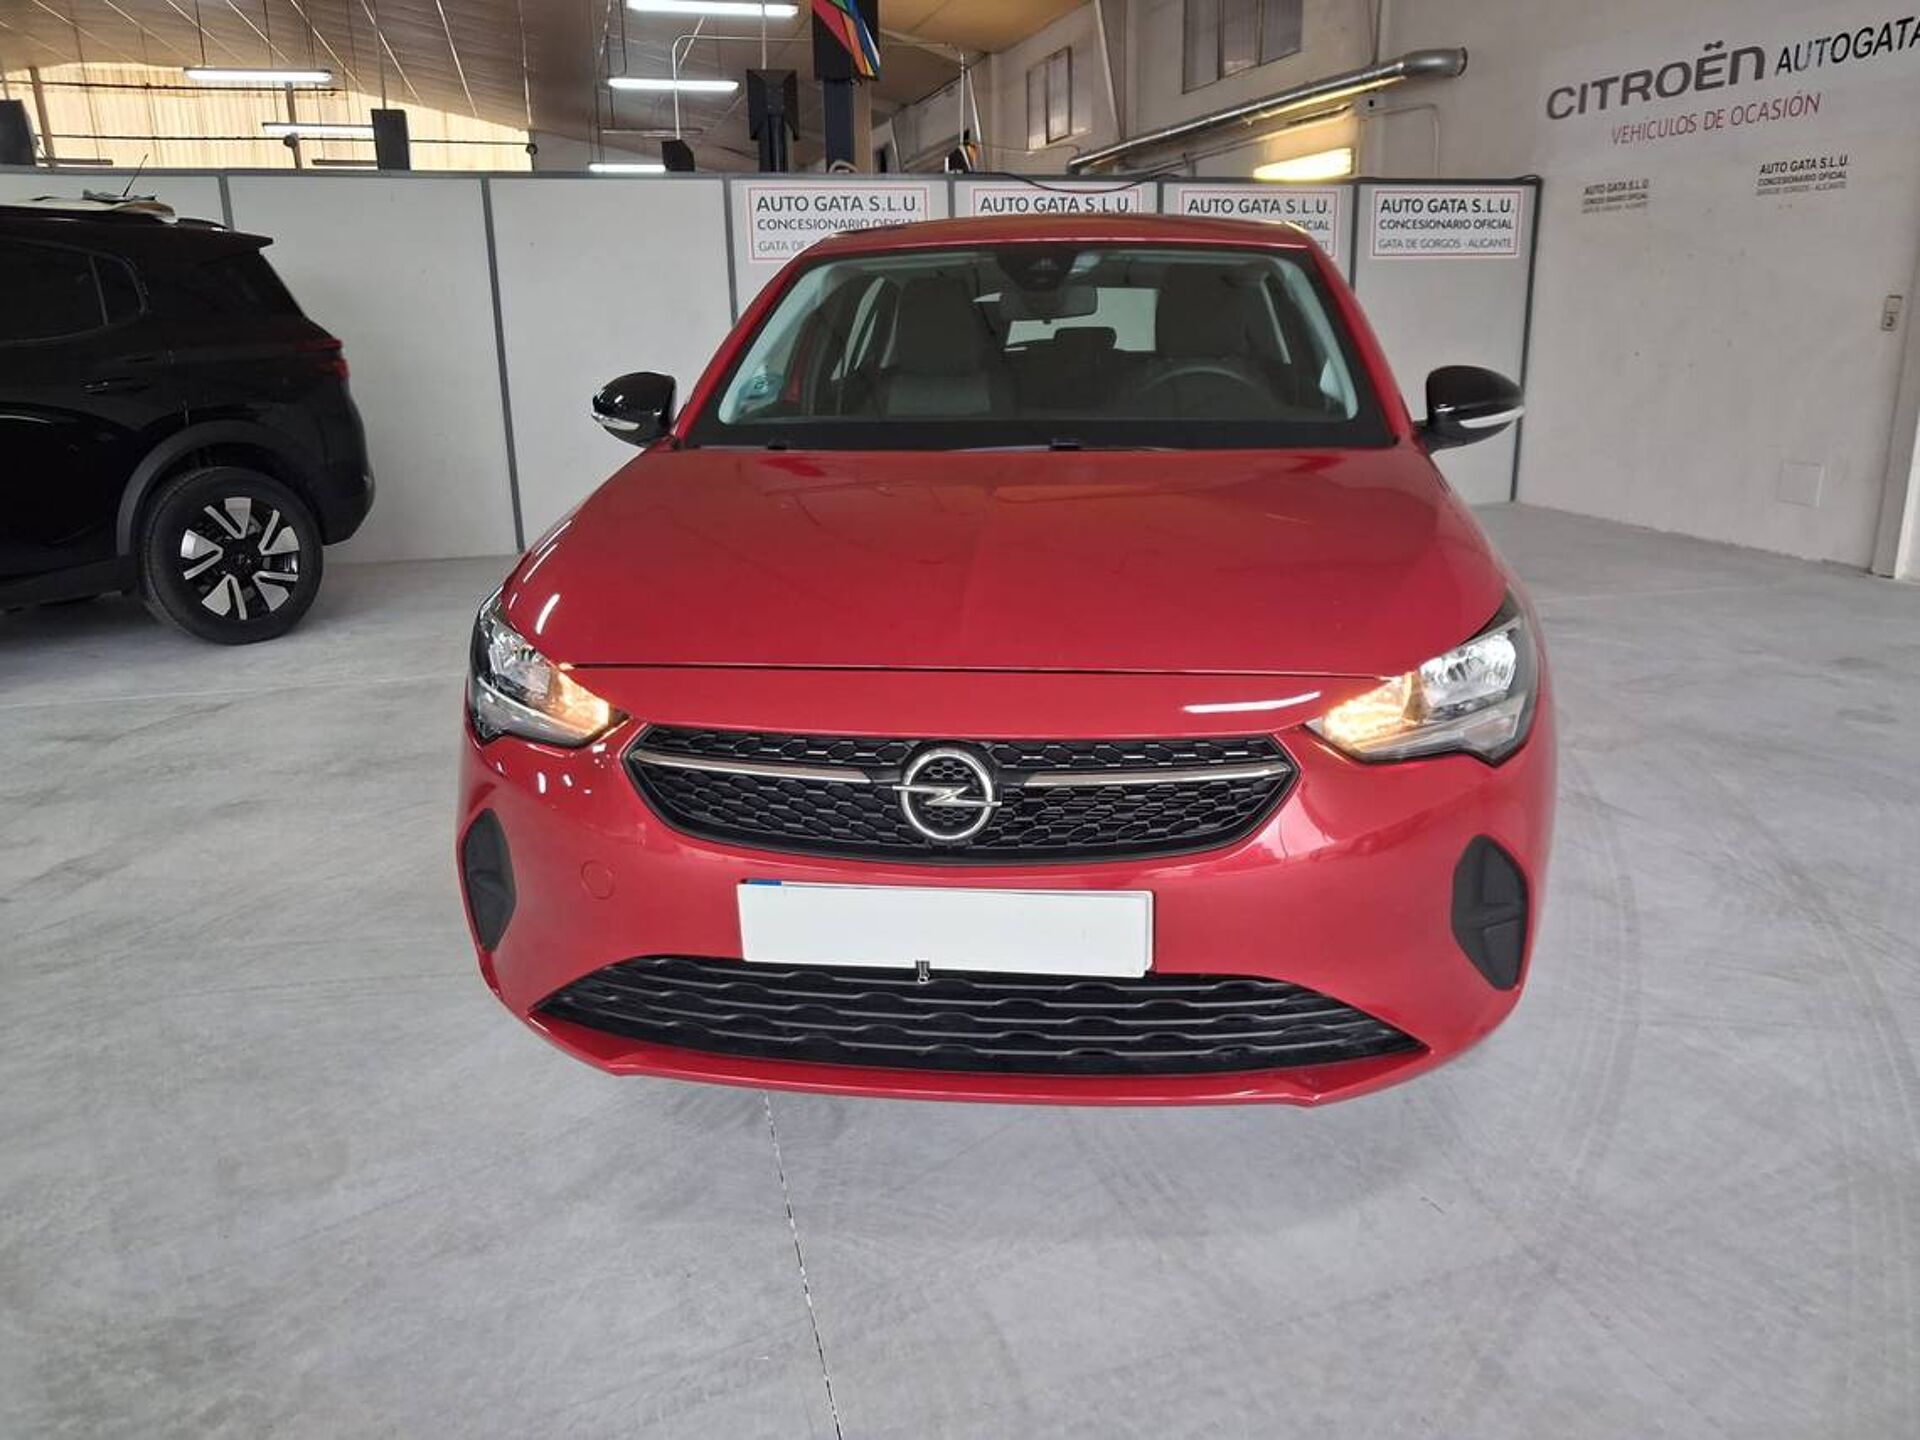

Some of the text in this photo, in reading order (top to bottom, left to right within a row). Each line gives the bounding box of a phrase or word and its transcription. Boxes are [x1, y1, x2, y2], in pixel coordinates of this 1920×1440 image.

[1703, 108, 1726, 131] DE
[1730, 92, 1822, 126] OCASIÓN
[1760, 161, 1787, 175] AUTO
[1790, 158, 1816, 172] GATA
[756, 196, 809, 212] AUTO
[814, 196, 863, 212] GATA
[980, 197, 1029, 213] AUTO
[1033, 197, 1080, 213] GATA
[1188, 198, 1234, 214] AUTO
[1238, 198, 1282, 214] GATA
[1380, 198, 1424, 213] AUTO
[1427, 198, 1468, 213] GATA
[757, 218, 870, 231] CONCESIONARIO
[1378, 218, 1513, 230] CONCESIONARIO OFICIAL
[758, 240, 789, 251] GATA
[1378, 237, 1512, 249] GATA DE GORGOS ALICANTE
